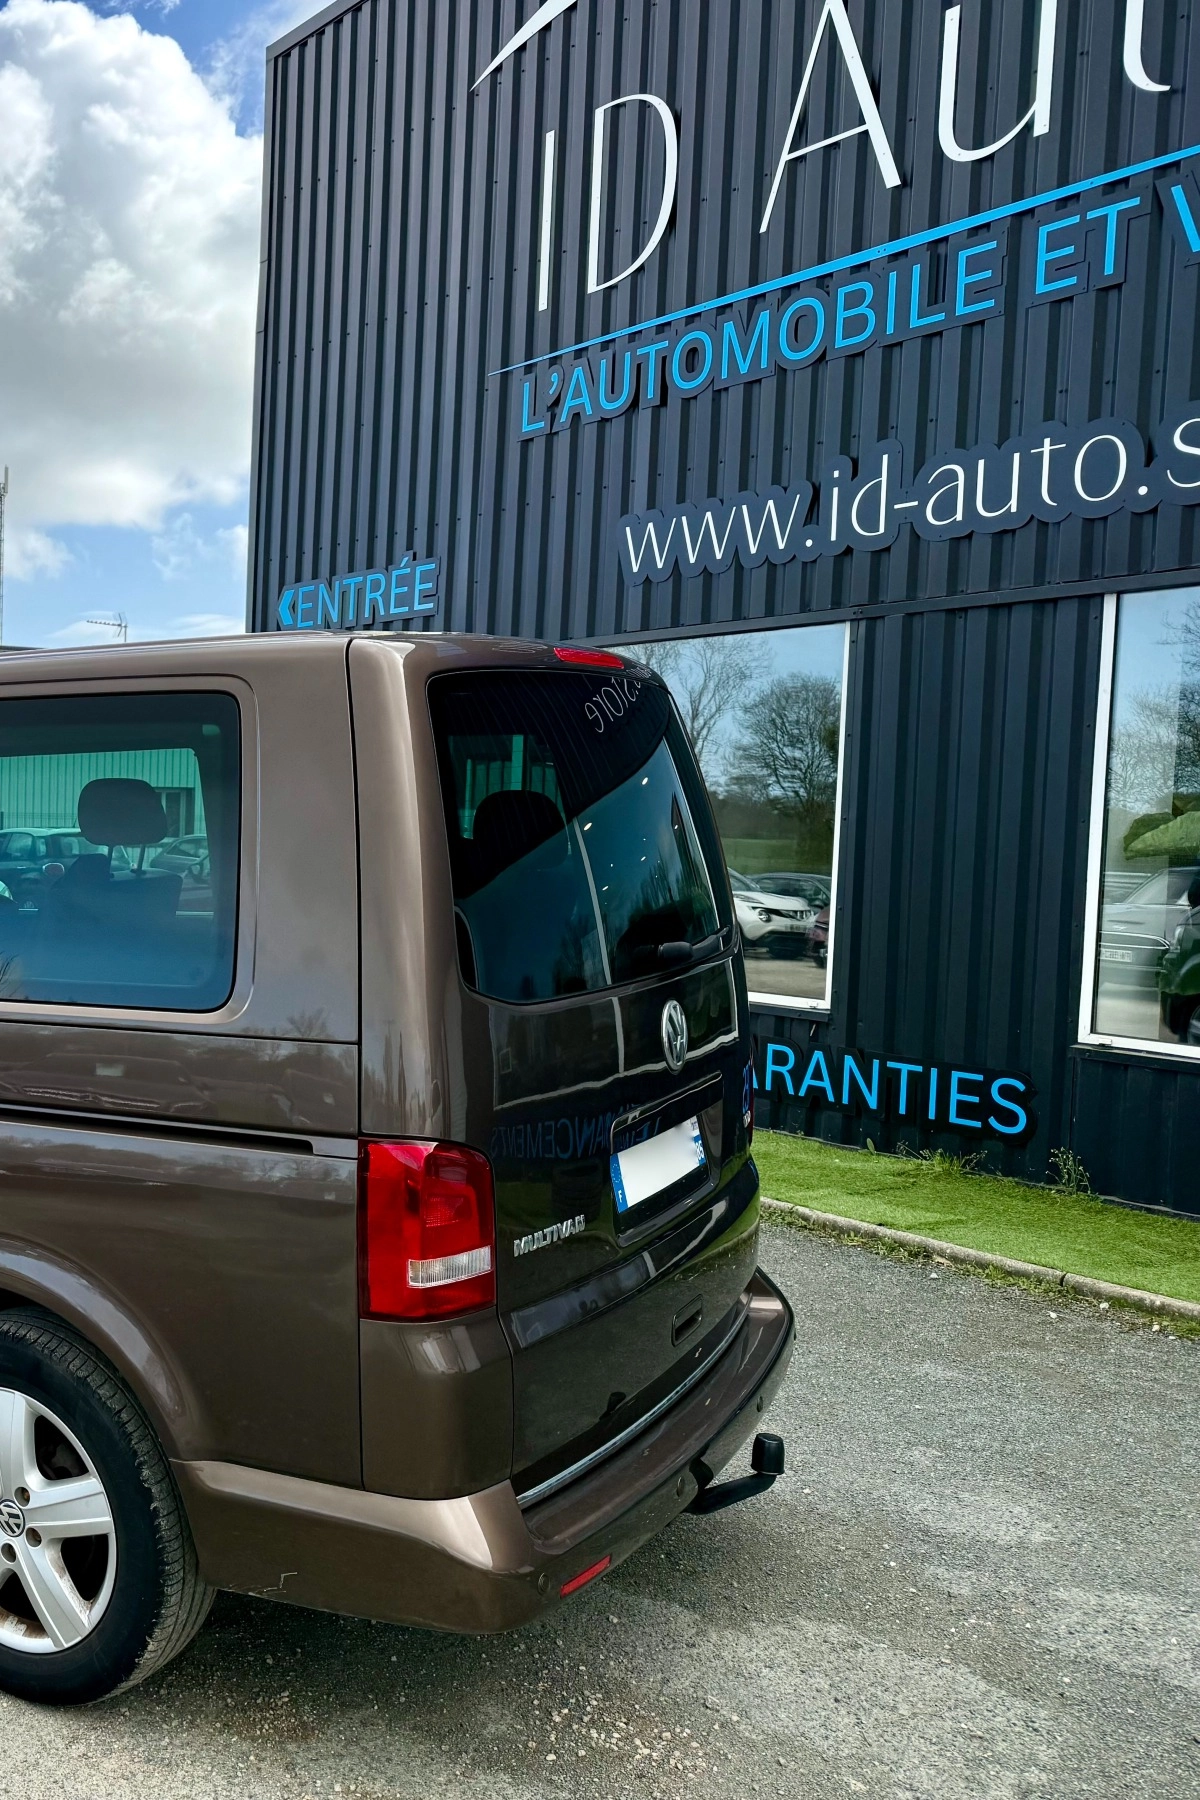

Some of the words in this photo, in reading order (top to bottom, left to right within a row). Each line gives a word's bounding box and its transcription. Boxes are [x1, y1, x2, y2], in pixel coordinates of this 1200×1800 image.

[521, 240, 998, 434] L'AUTOMOBILE
[1035, 196, 1141, 295] ET
[297, 556, 436, 628] ENTRÉE
[752, 1043, 1028, 1135] RANTIES
[513, 1213, 586, 1258] MULTIVAN
